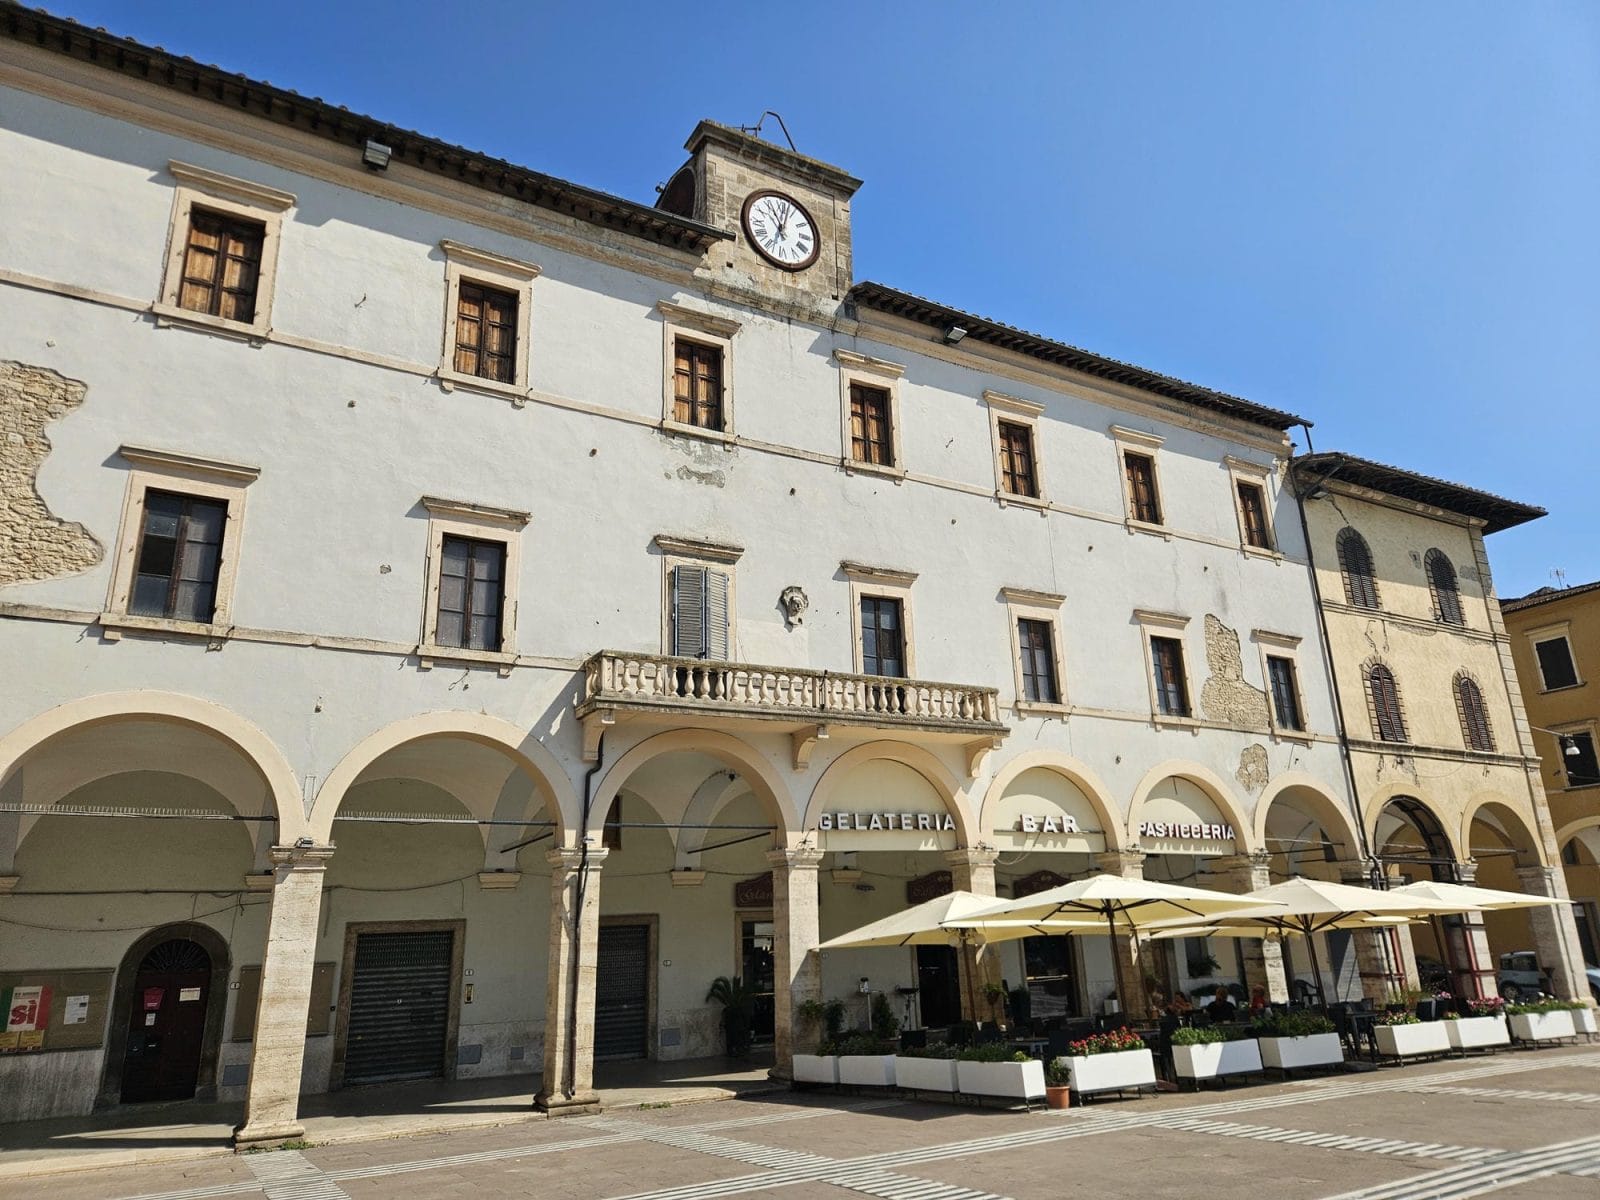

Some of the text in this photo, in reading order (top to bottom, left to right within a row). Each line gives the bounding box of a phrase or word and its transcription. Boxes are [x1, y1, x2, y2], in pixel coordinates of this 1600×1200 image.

[798, 232, 811, 241] III
[820, 813, 956, 831] GELATERIA
[1021, 814, 1081, 833] BAR
[1139, 821, 1236, 840] PASTICCERIA
